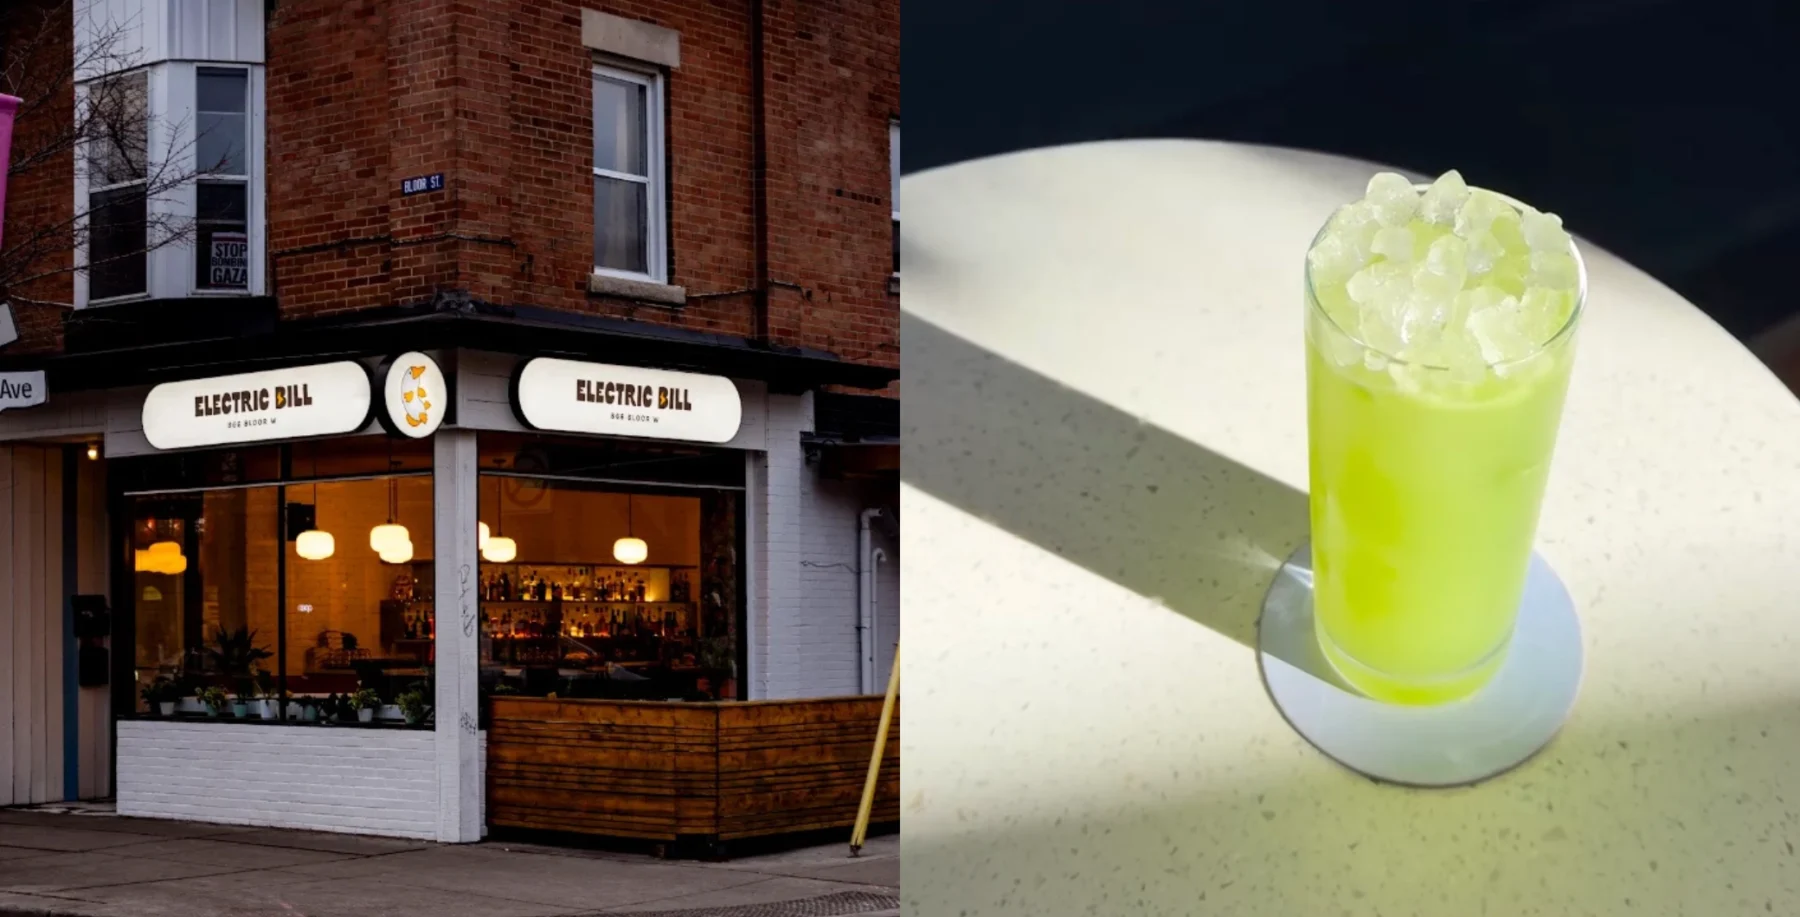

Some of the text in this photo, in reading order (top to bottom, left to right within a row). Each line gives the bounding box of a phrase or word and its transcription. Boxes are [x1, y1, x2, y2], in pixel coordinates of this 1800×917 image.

[404, 174, 442, 194] BLOOR ST.
[215, 243, 247, 257] STOP
[211, 257, 247, 267] BOMBIN
[213, 268, 247, 284] GAZA
[0, 379, 33, 399] Ave
[576, 379, 692, 411] ELECTRIC BILL
[194, 383, 313, 417] ELECTRIC BILL
[244, 418, 268, 428] BLOOR
[627, 414, 650, 422] BLOOR
